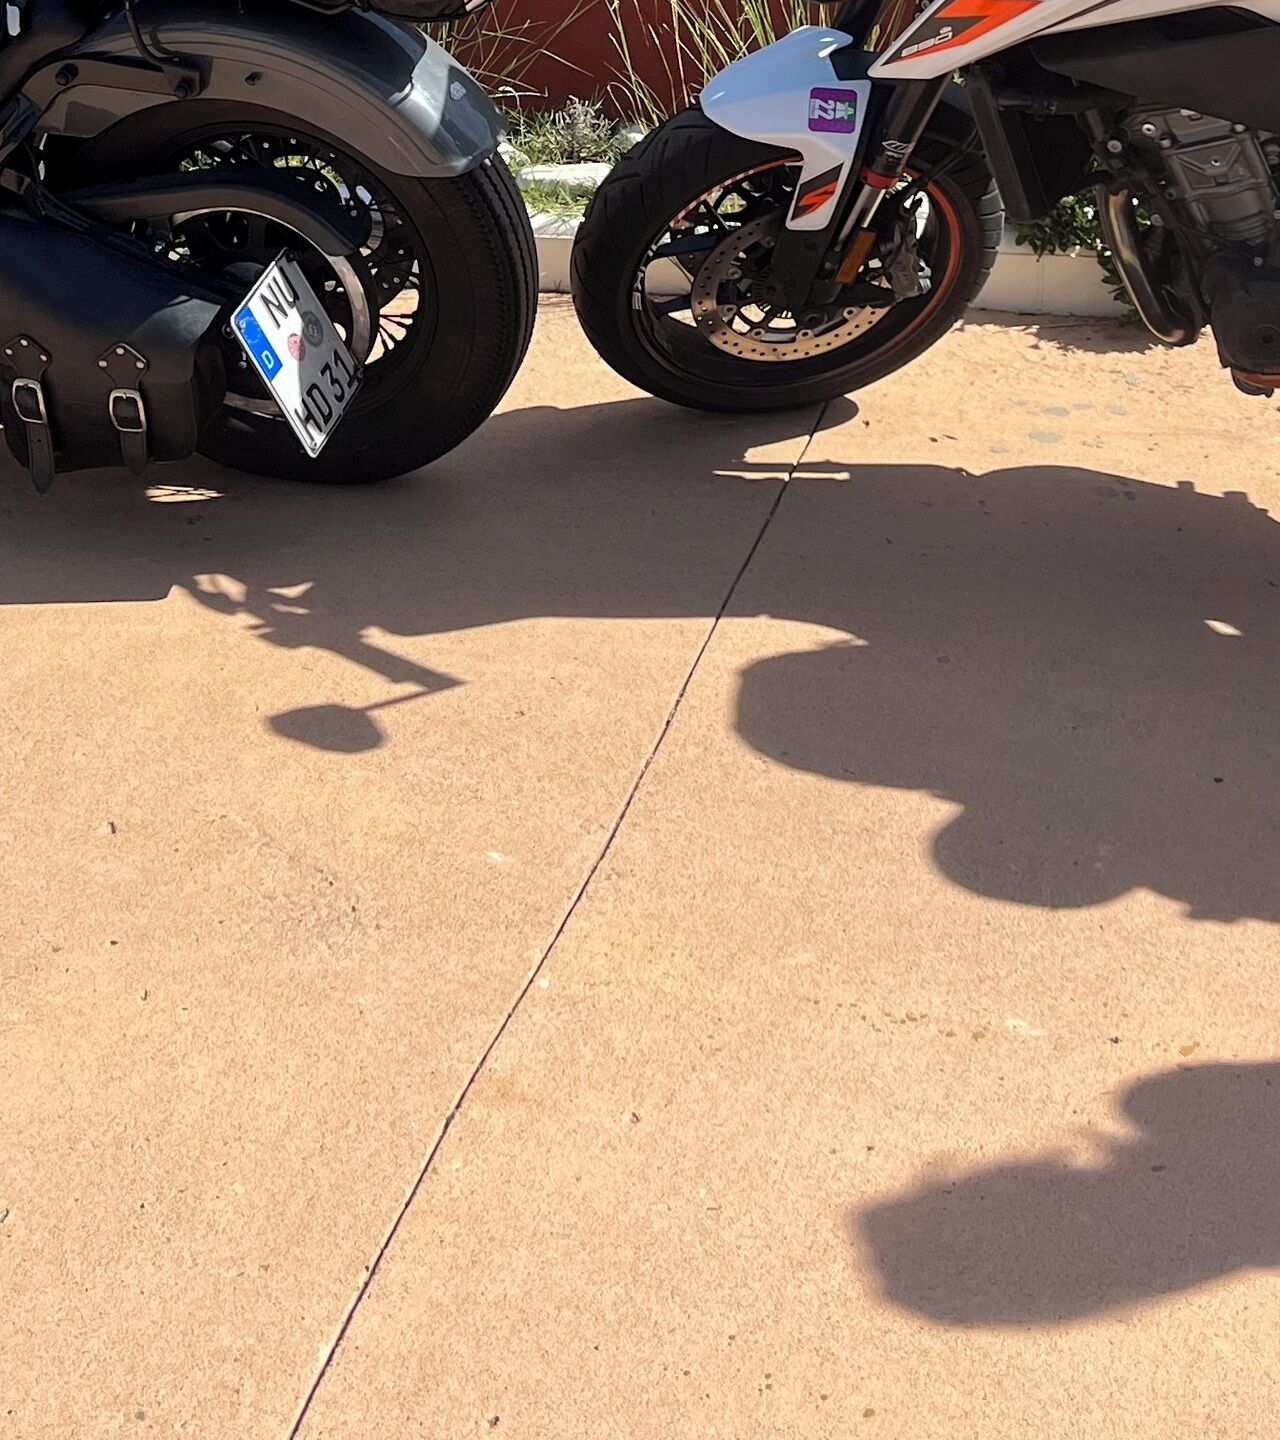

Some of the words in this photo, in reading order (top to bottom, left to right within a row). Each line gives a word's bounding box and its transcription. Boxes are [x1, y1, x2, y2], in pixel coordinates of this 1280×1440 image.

[814, 98, 836, 121] 22
[259, 266, 300, 329] NU
[261, 351, 275, 369] D
